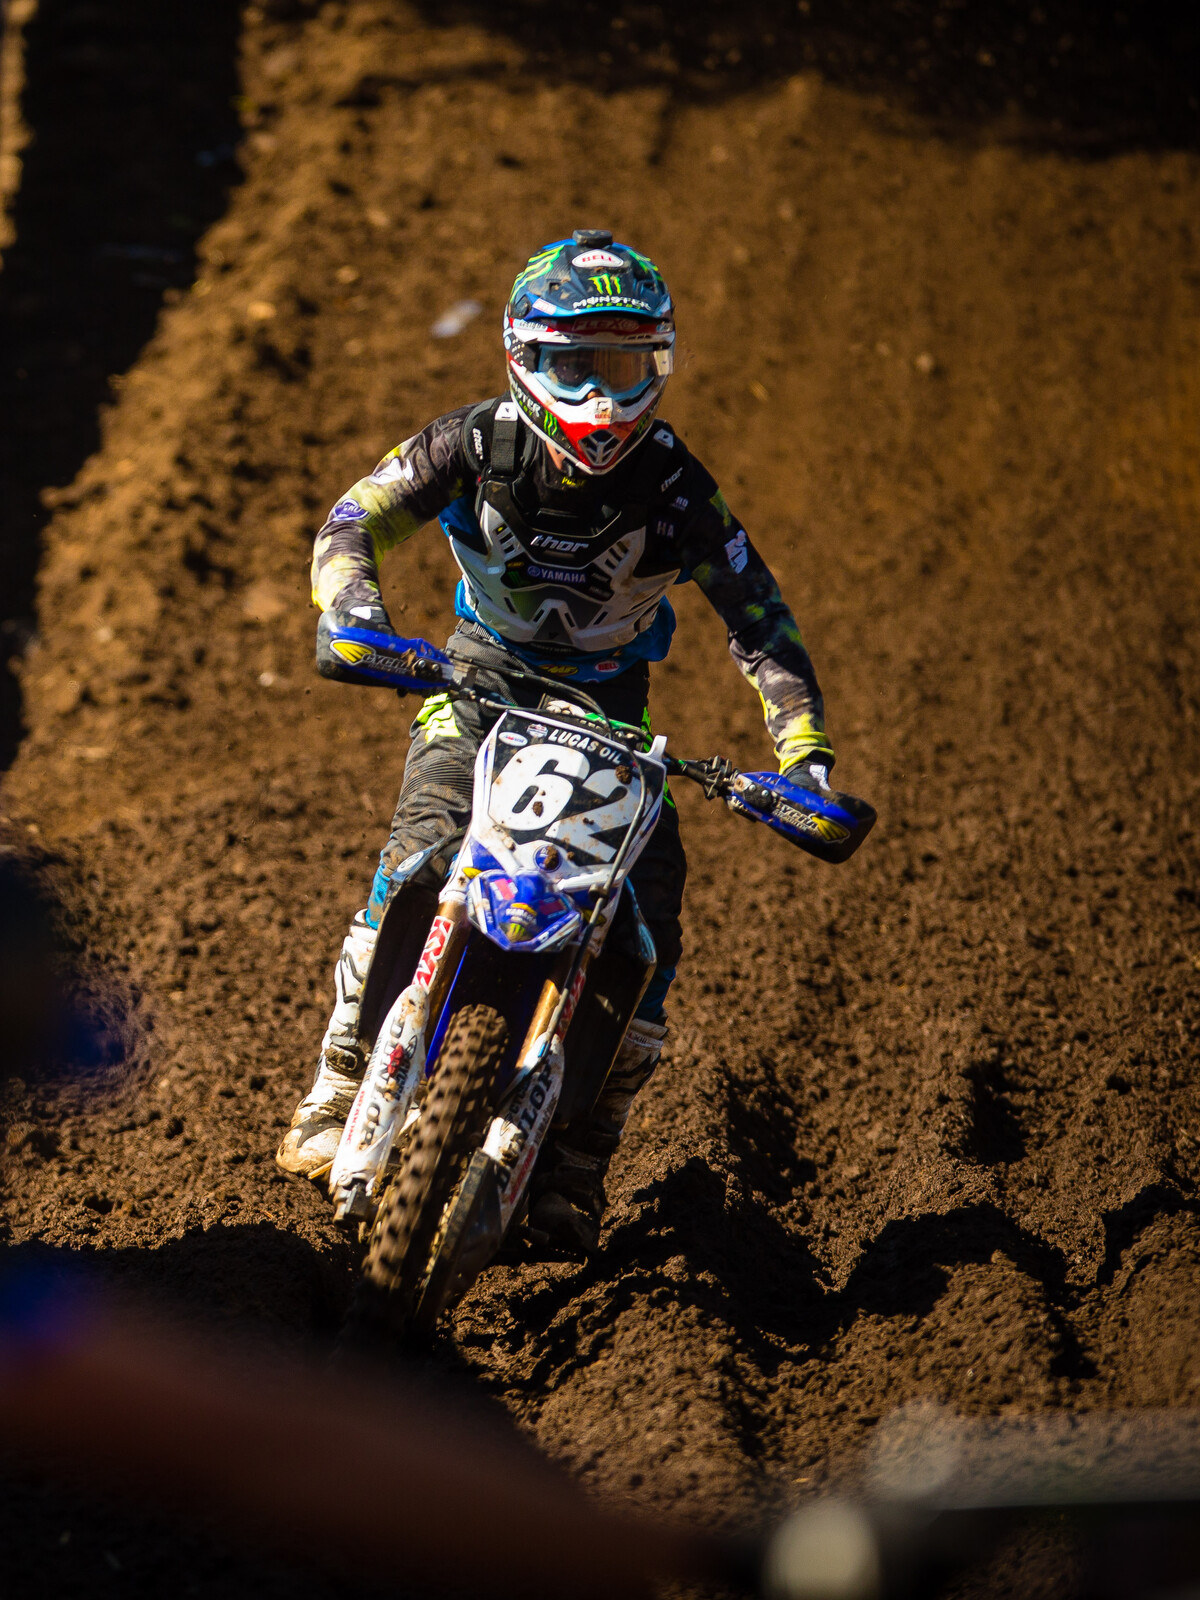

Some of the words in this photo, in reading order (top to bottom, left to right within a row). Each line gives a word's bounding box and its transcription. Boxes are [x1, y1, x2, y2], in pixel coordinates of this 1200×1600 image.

[581, 254, 614, 264] BELL
[573, 295, 652, 311] MONSTER
[530, 534, 590, 553] thor
[541, 568, 587, 584] YAMAHA
[548, 728, 599, 751] LUCAS
[599, 747, 623, 764] OIL
[488, 743, 653, 863] 62
